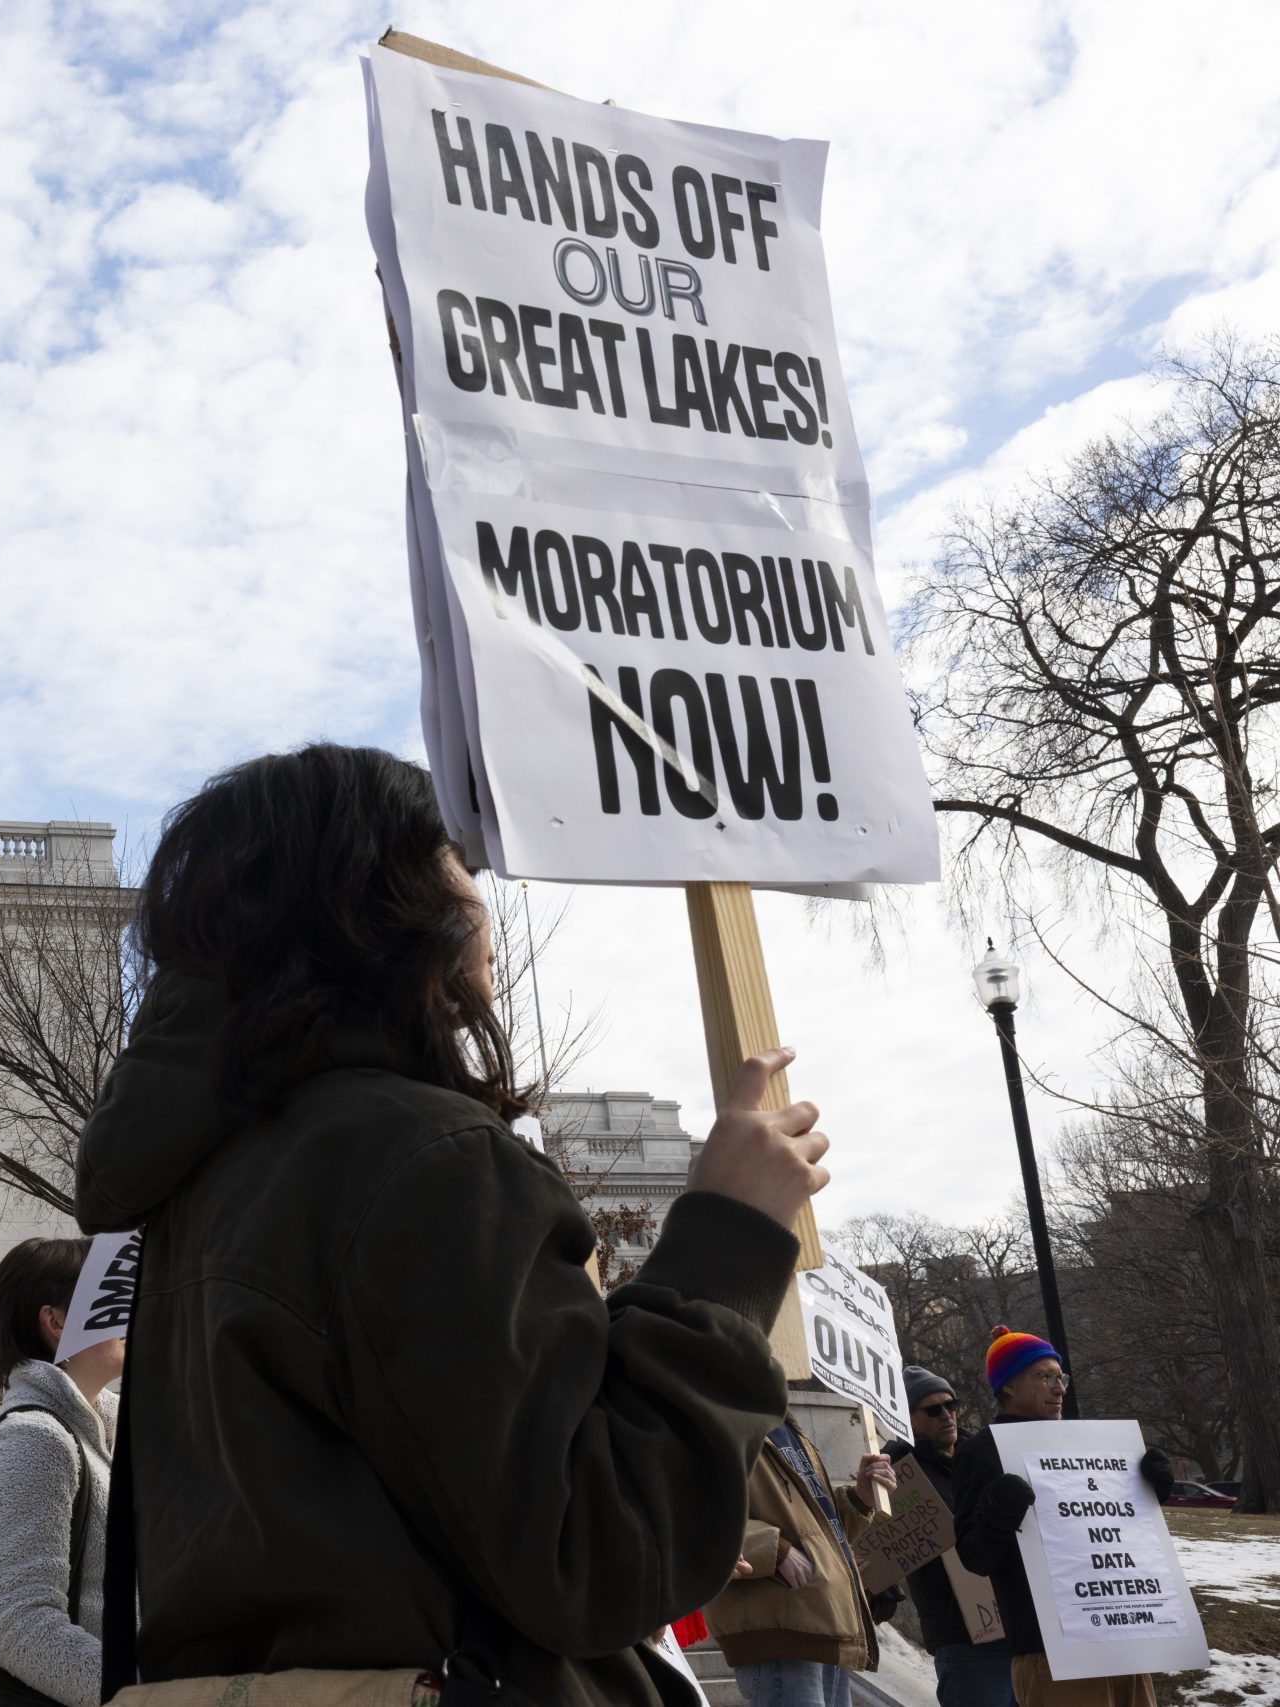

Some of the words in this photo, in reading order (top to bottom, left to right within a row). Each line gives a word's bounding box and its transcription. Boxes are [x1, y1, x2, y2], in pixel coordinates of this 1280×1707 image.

[431, 106, 661, 250] HANDS
[671, 164, 778, 272] OFF
[552, 237, 708, 326] OUR
[436, 289, 627, 419] GREAT
[637, 328, 834, 450] LAKES!
[475, 520, 875, 656] MORATORIUM
[585, 663, 839, 822] NOW!
[83, 1234, 141, 1331] AMER
[805, 1272, 890, 1342] Oracle
[814, 1314, 898, 1411] OUT!
[830, 1373, 843, 1388] FOR
[1039, 1458, 1128, 1472] HEALTHCARE
[1087, 1478, 1099, 1491] &
[857, 1499, 940, 1556] SENATORS
[1058, 1501, 1136, 1518] SCHOOLS
[882, 1518, 939, 1560] PROTECT
[897, 1539, 941, 1572] BWCA
[1087, 1527, 1122, 1543] NOT
[1091, 1552, 1136, 1570] DATA
[1074, 1578, 1162, 1598] CENTERS!
[1090, 1613, 1101, 1626] @
